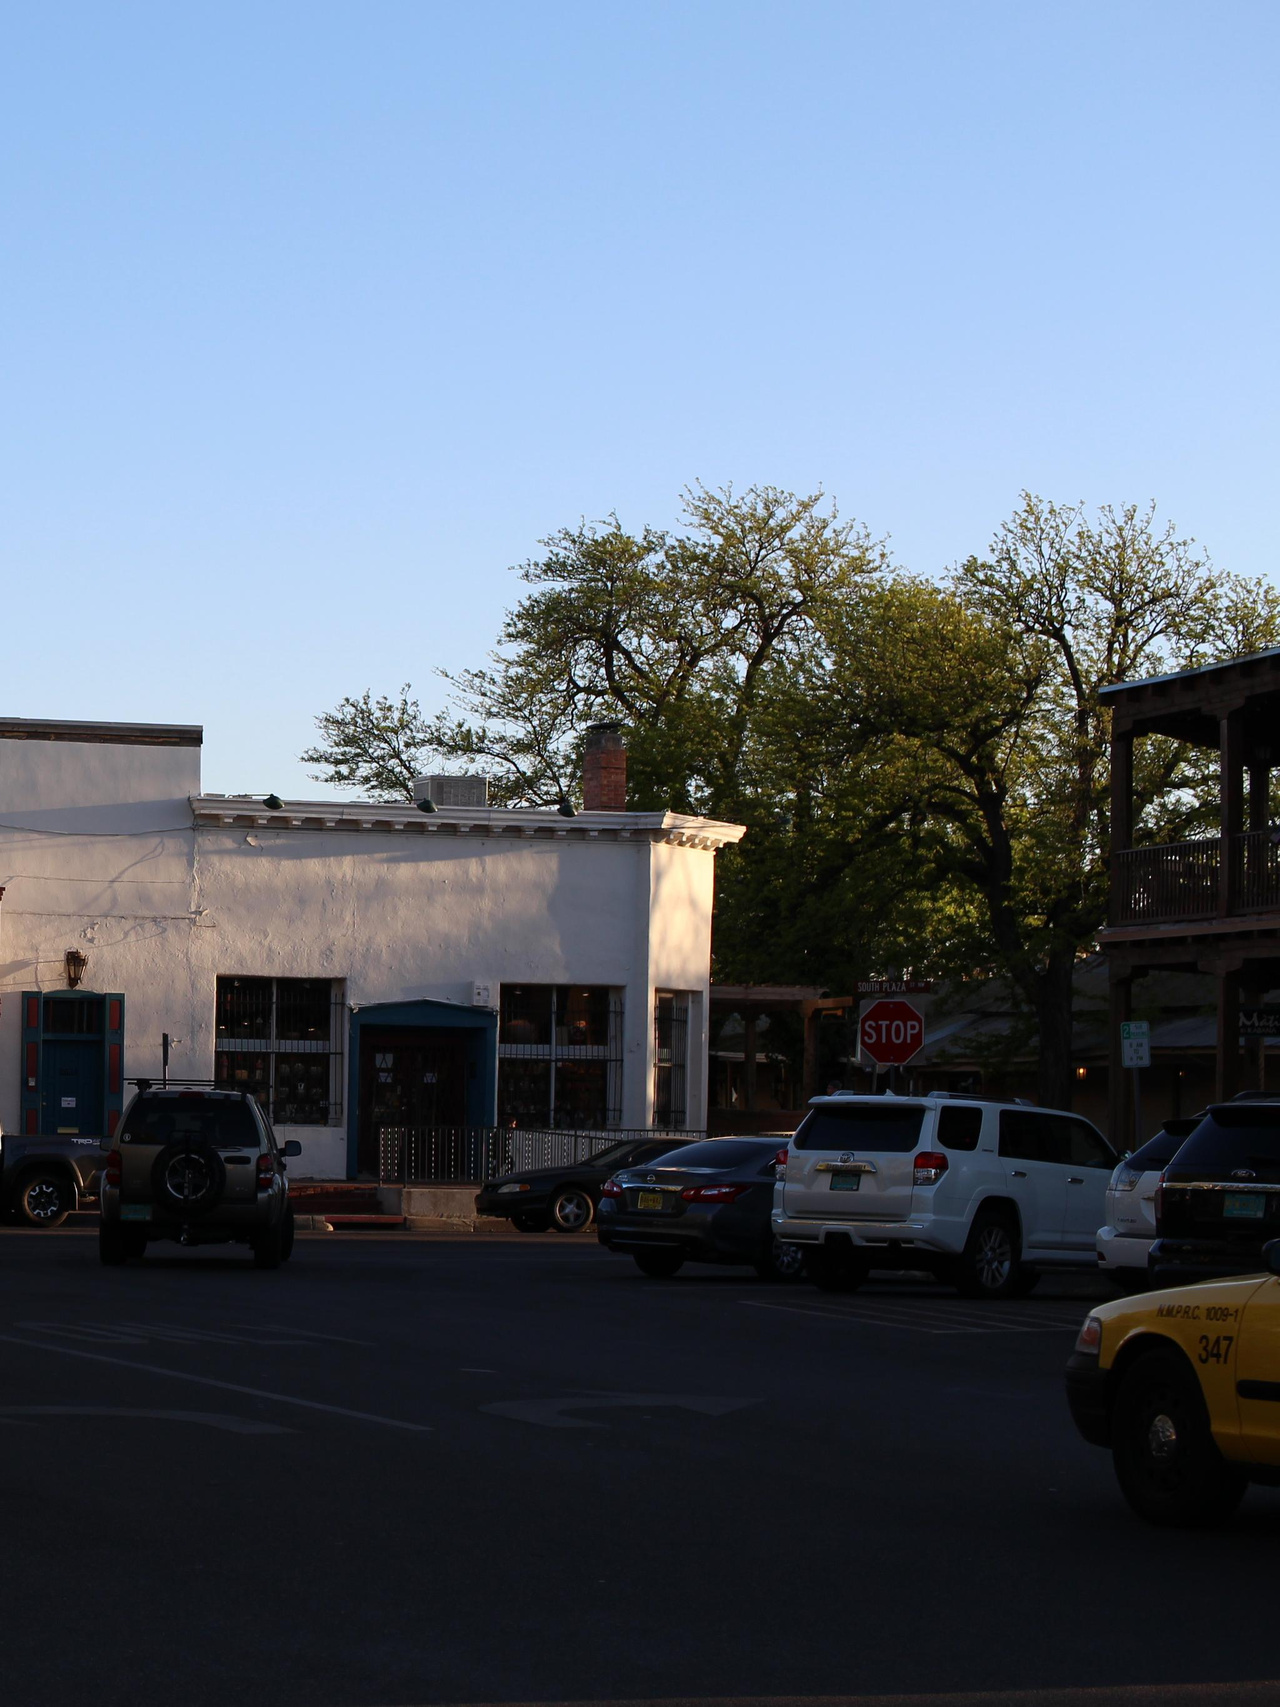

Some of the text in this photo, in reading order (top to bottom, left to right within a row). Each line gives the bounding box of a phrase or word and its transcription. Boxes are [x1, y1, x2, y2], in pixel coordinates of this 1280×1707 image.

[857, 981, 880, 992] SOUTH
[882, 981, 907, 992] PLAZA
[863, 1020, 920, 1044] STOP
[1123, 1026, 1129, 1037] 2
[1205, 1306, 1239, 1322] 1009-1
[1198, 1334, 1234, 1365] 347
